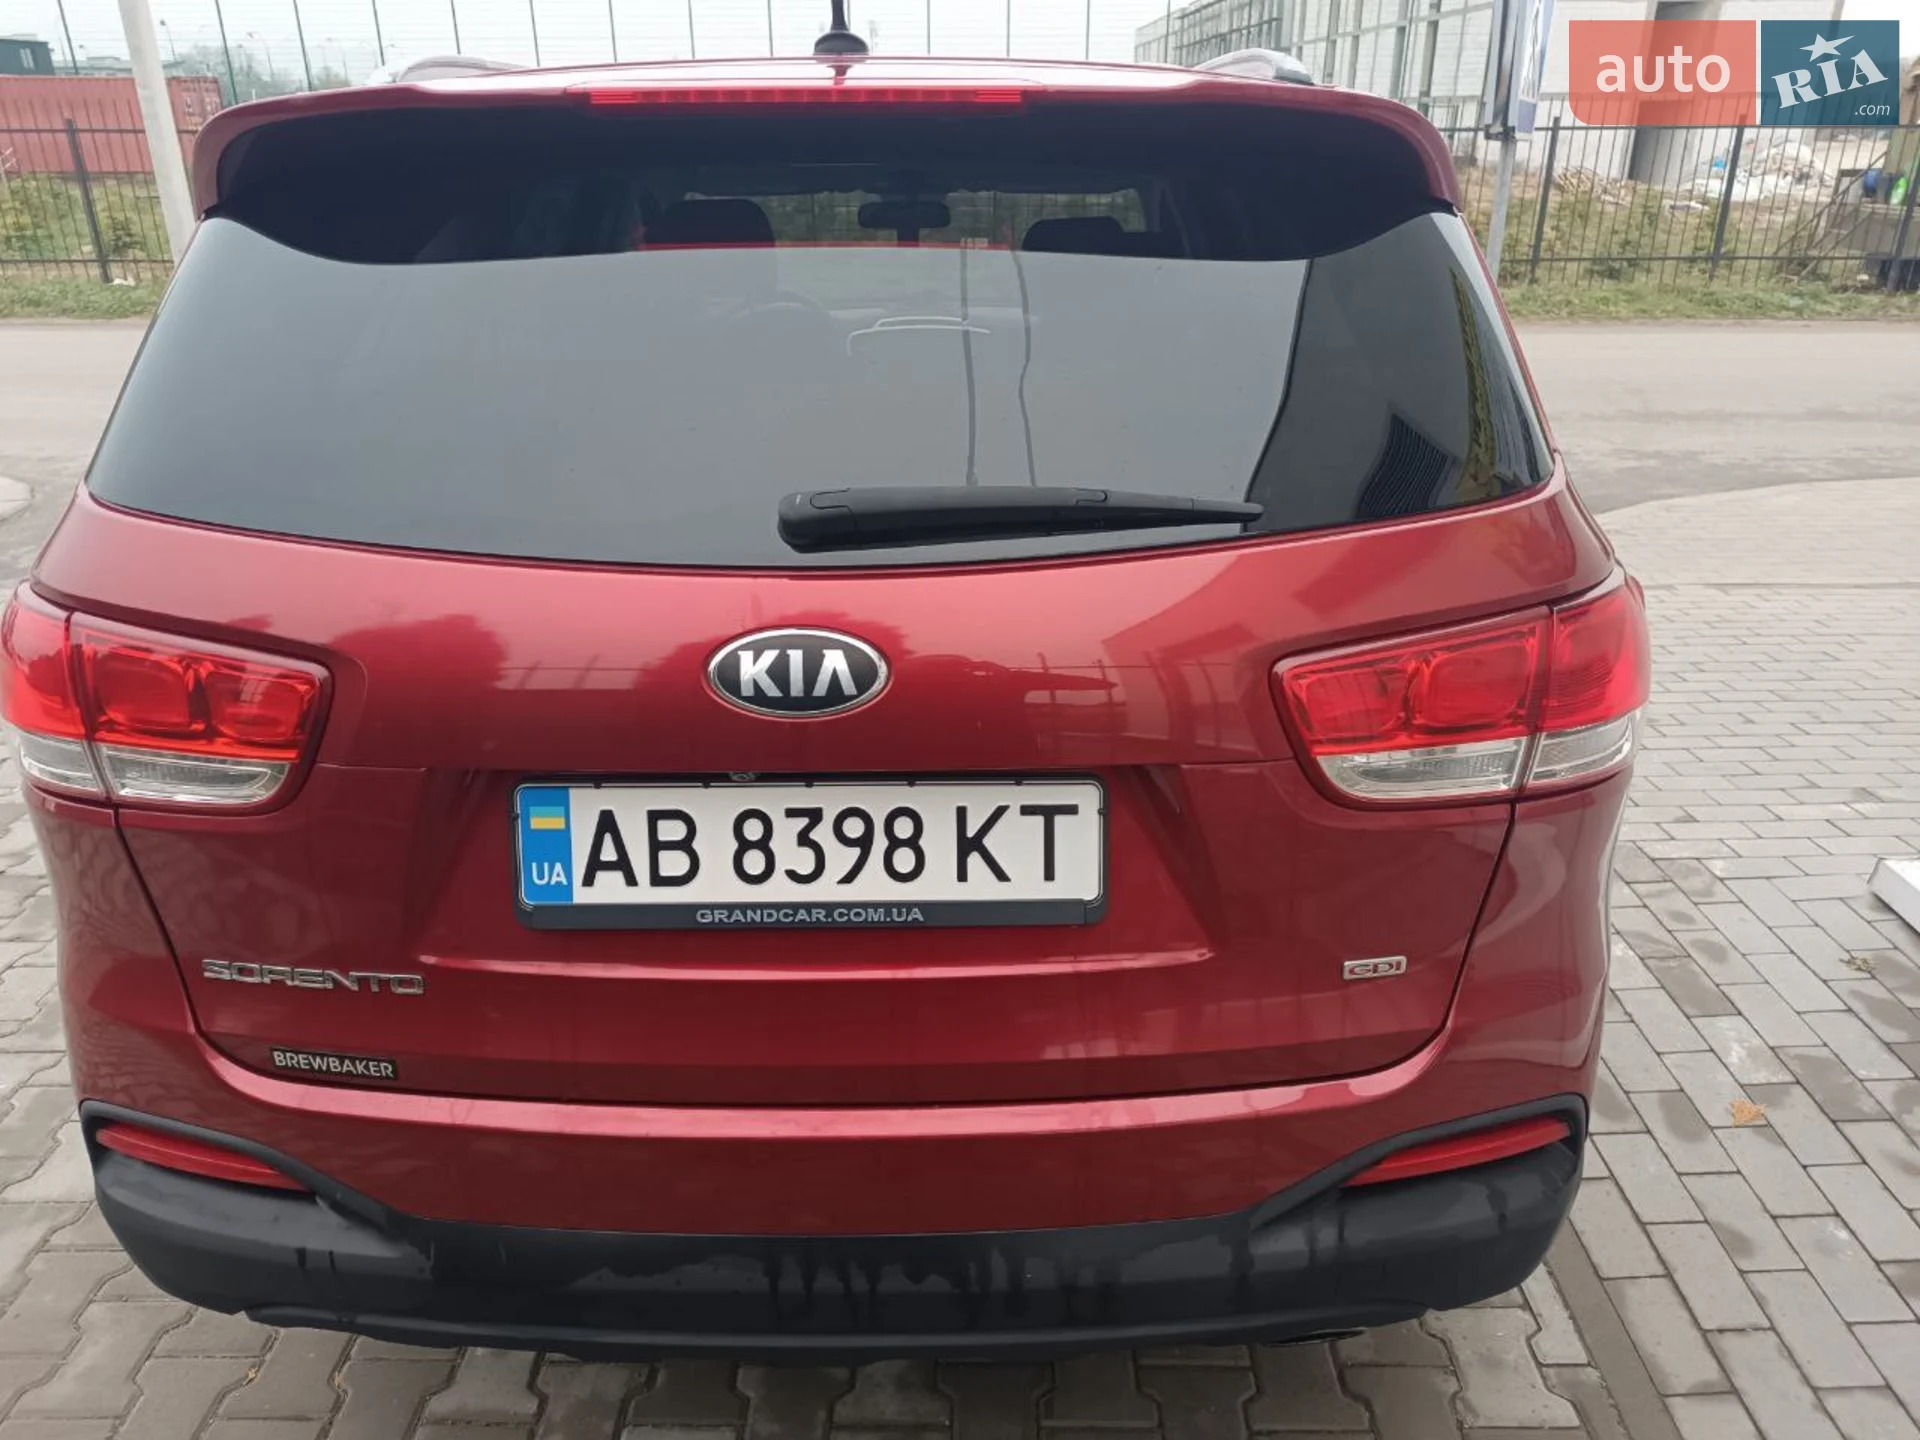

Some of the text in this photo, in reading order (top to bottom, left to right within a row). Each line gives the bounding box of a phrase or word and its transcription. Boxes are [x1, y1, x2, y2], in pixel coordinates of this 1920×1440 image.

[737, 649, 858, 698] KIA
[581, 804, 1079, 887] AB 8398 KT
[531, 862, 569, 886] UA
[696, 907, 925, 923] GRANDCAR.COM.UA
[202, 959, 425, 995] SORENTO
[272, 1050, 395, 1078] BREWBAKER
